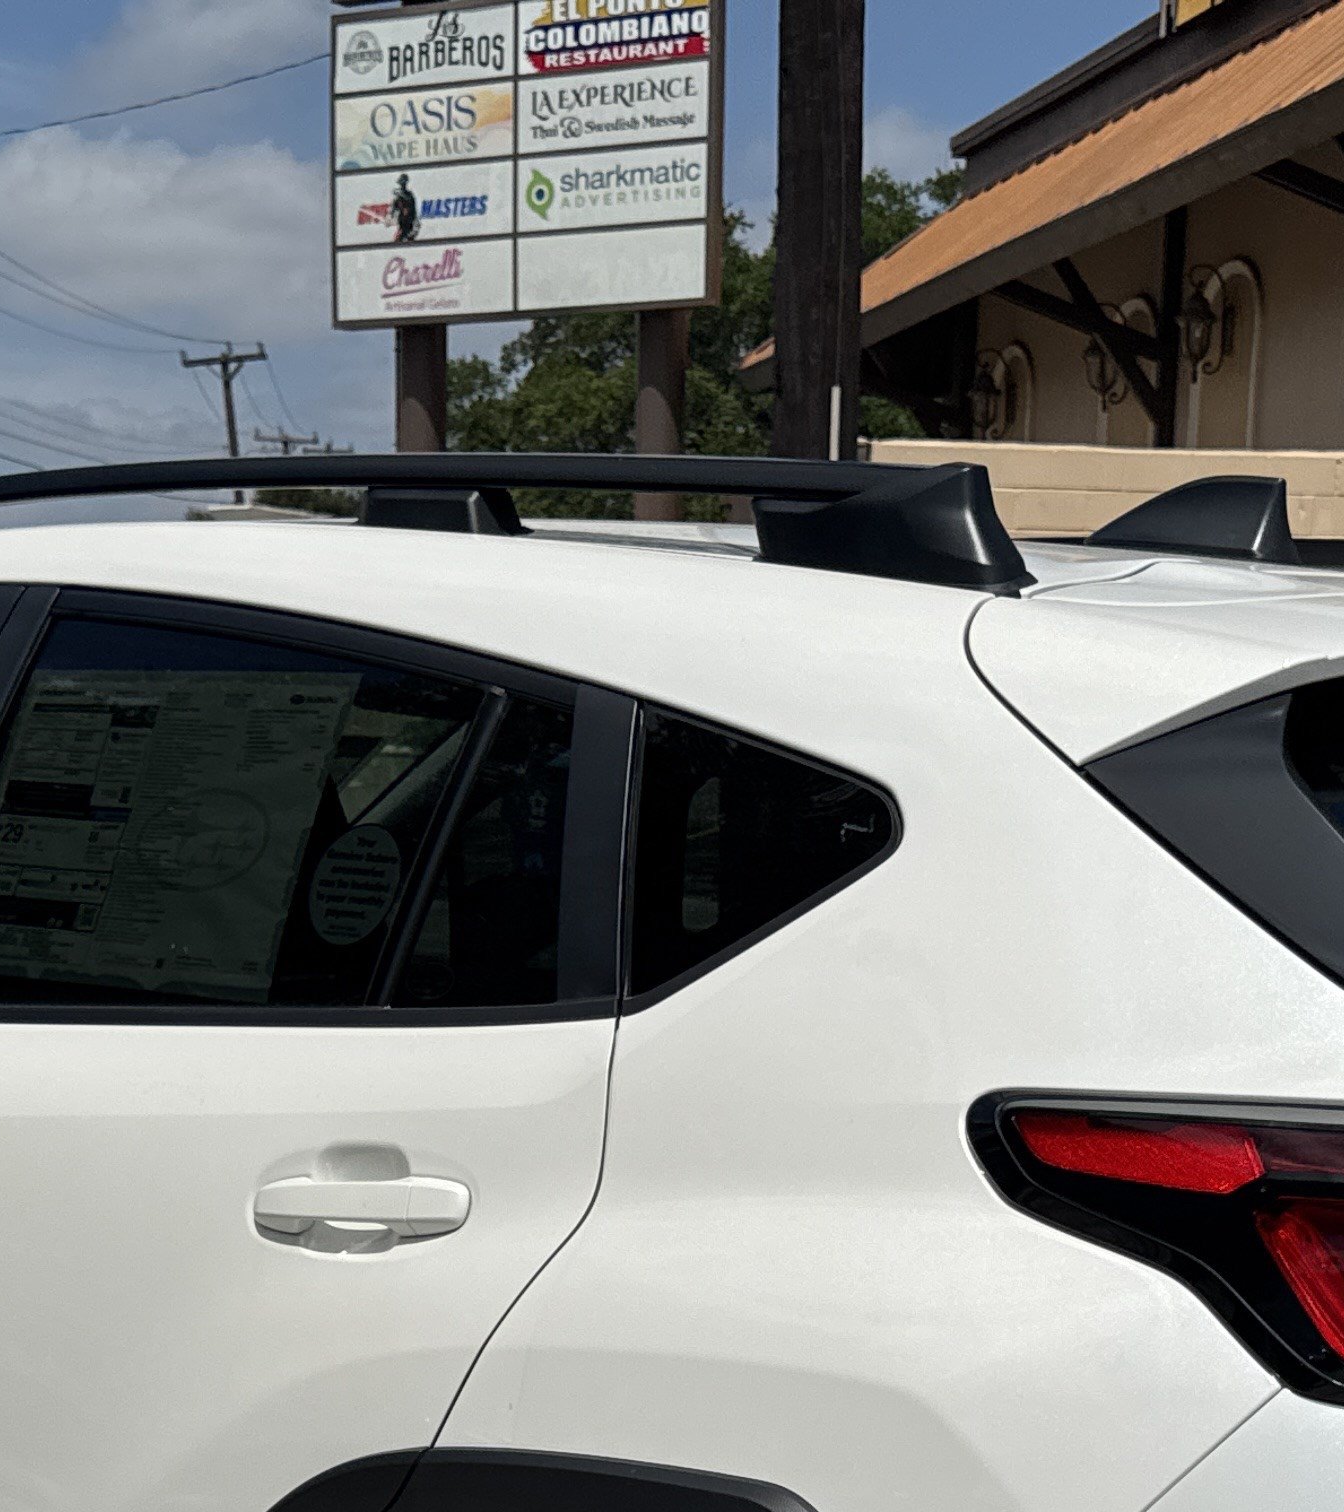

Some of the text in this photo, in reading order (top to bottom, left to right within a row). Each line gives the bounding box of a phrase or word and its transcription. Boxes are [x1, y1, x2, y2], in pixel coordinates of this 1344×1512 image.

[529, 10, 709, 51] COLOMBIANO
[389, 34, 504, 83] BARBEROS
[544, 38, 689, 68] RESTAURANT
[558, 76, 698, 112] EXPERIENCE
[370, 94, 477, 138] OASIS
[560, 158, 701, 193] sharkmatic
[560, 185, 701, 209] ADVERTISING
